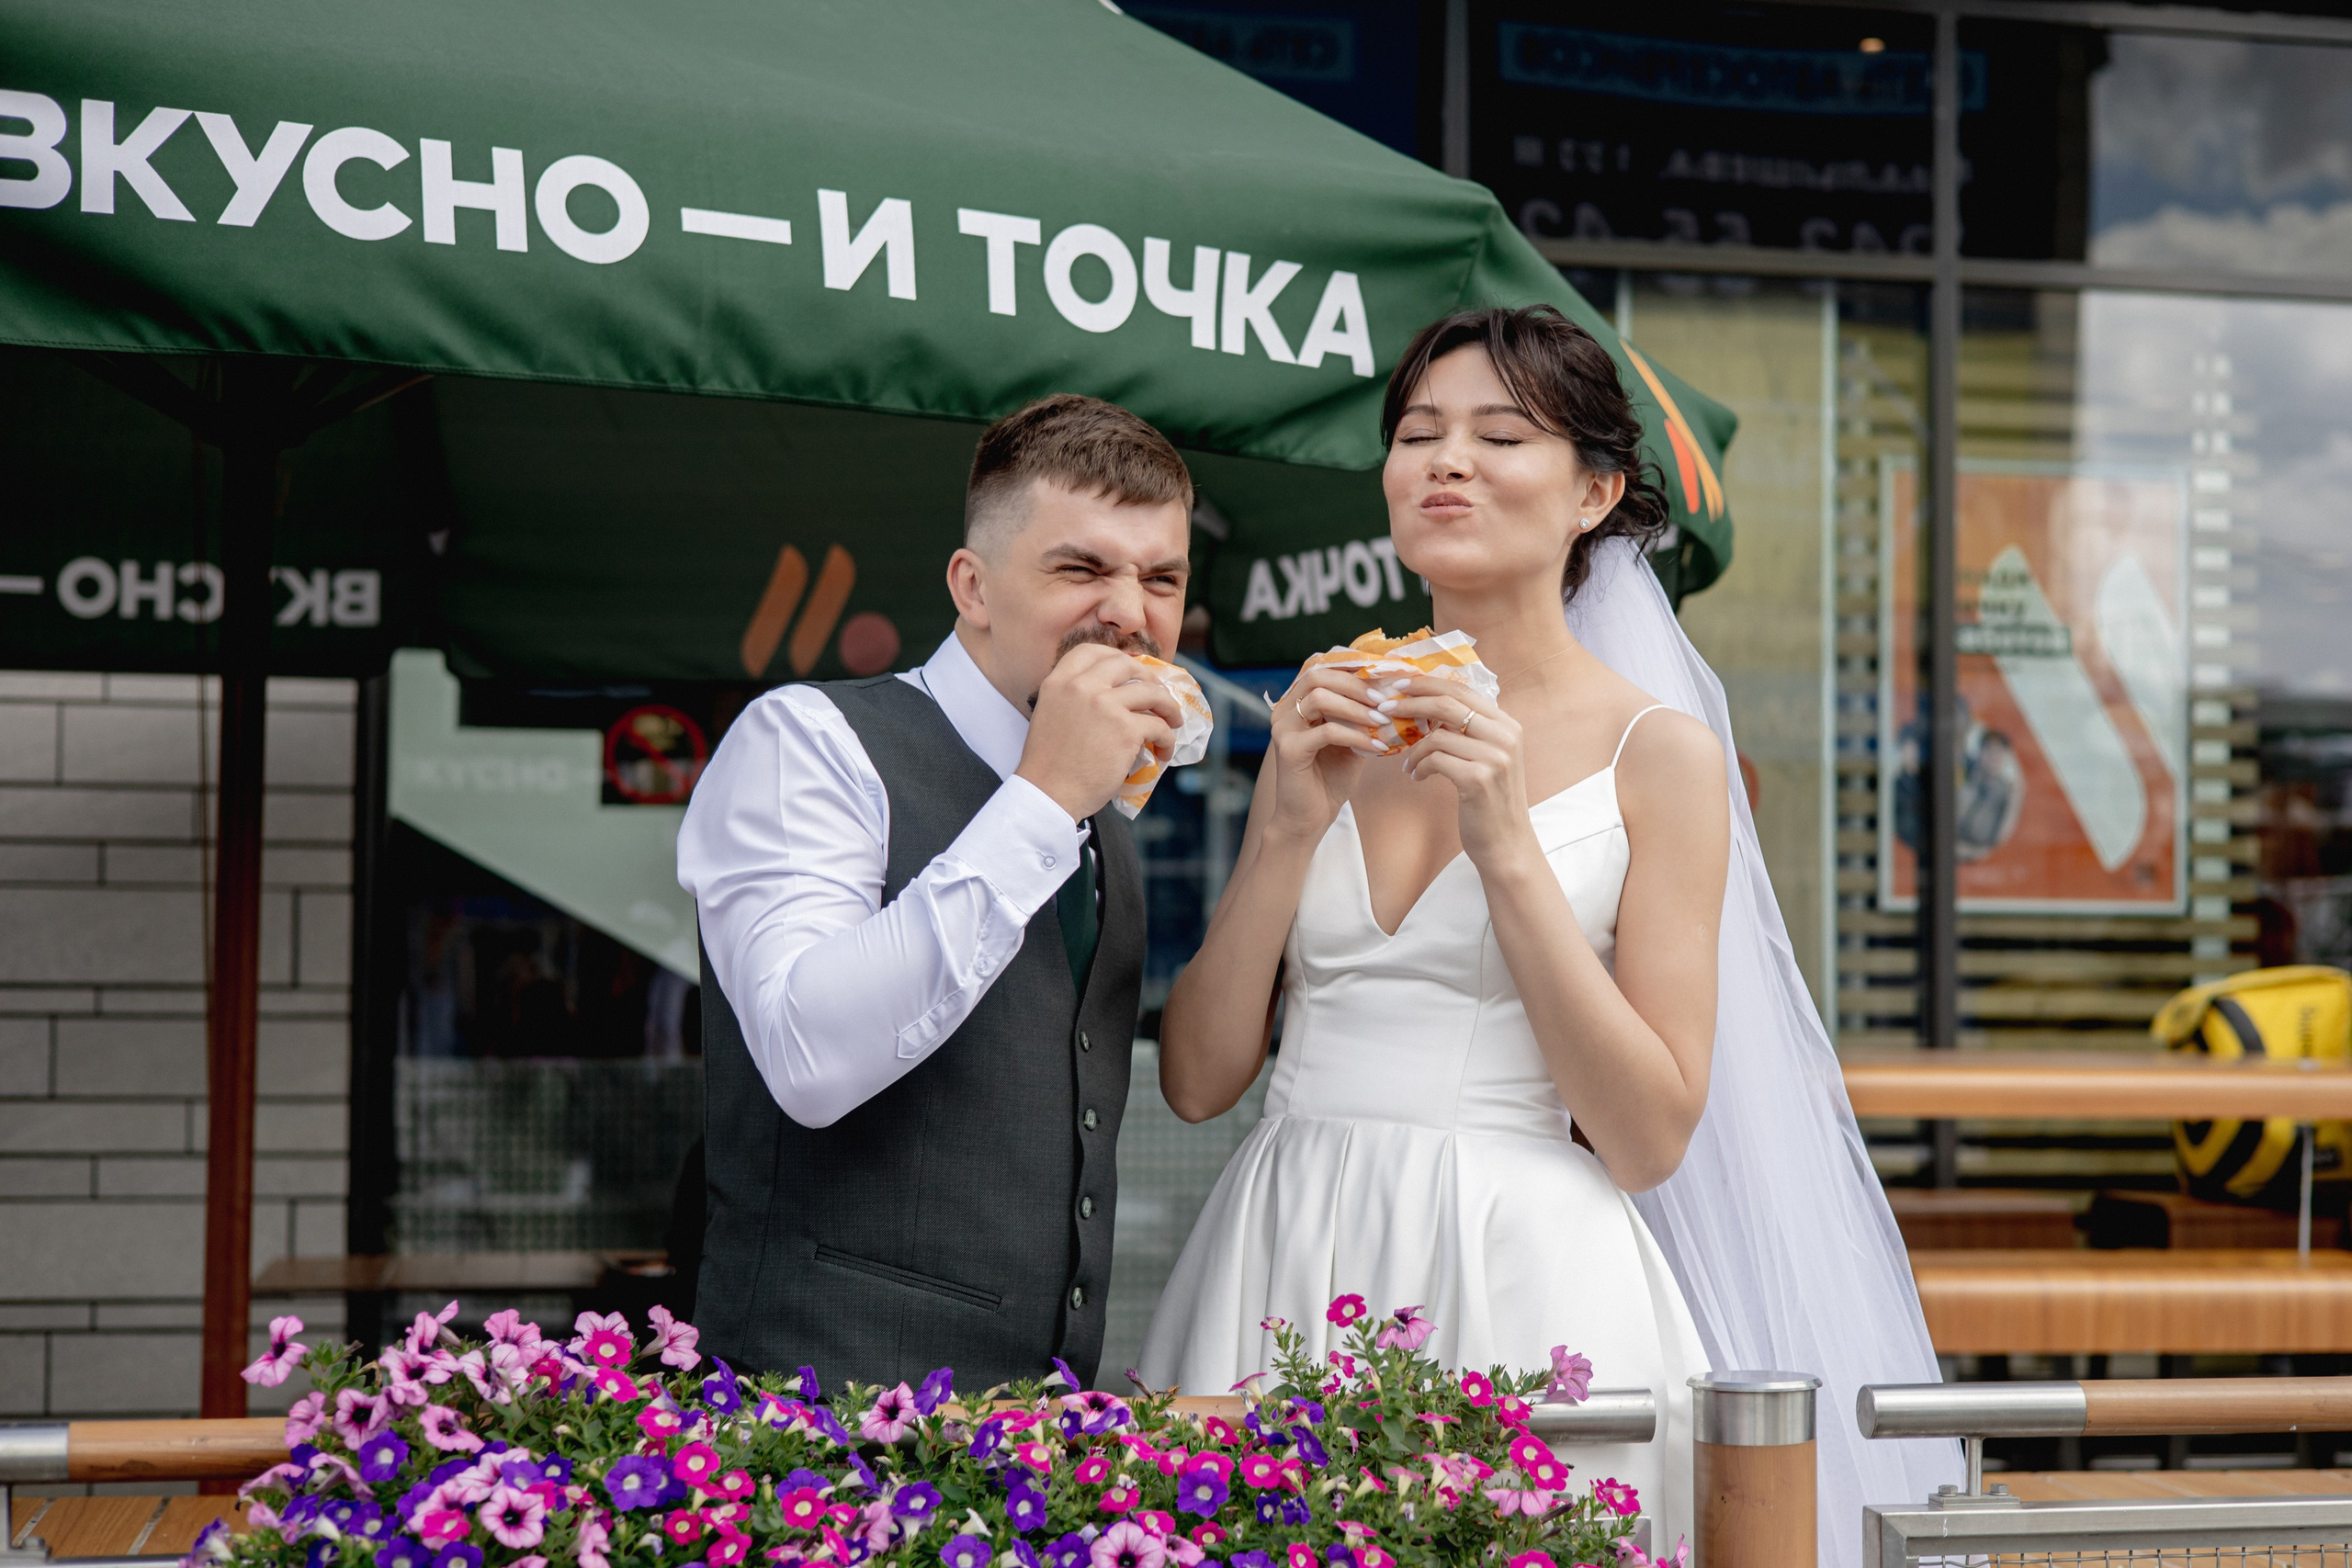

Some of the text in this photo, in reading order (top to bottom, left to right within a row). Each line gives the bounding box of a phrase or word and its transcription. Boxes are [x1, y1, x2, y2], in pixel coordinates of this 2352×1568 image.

[0, 89, 650, 265] ВКУСНО
[817, 188, 917, 301] И
[957, 208, 1375, 378] ТОЧКА
